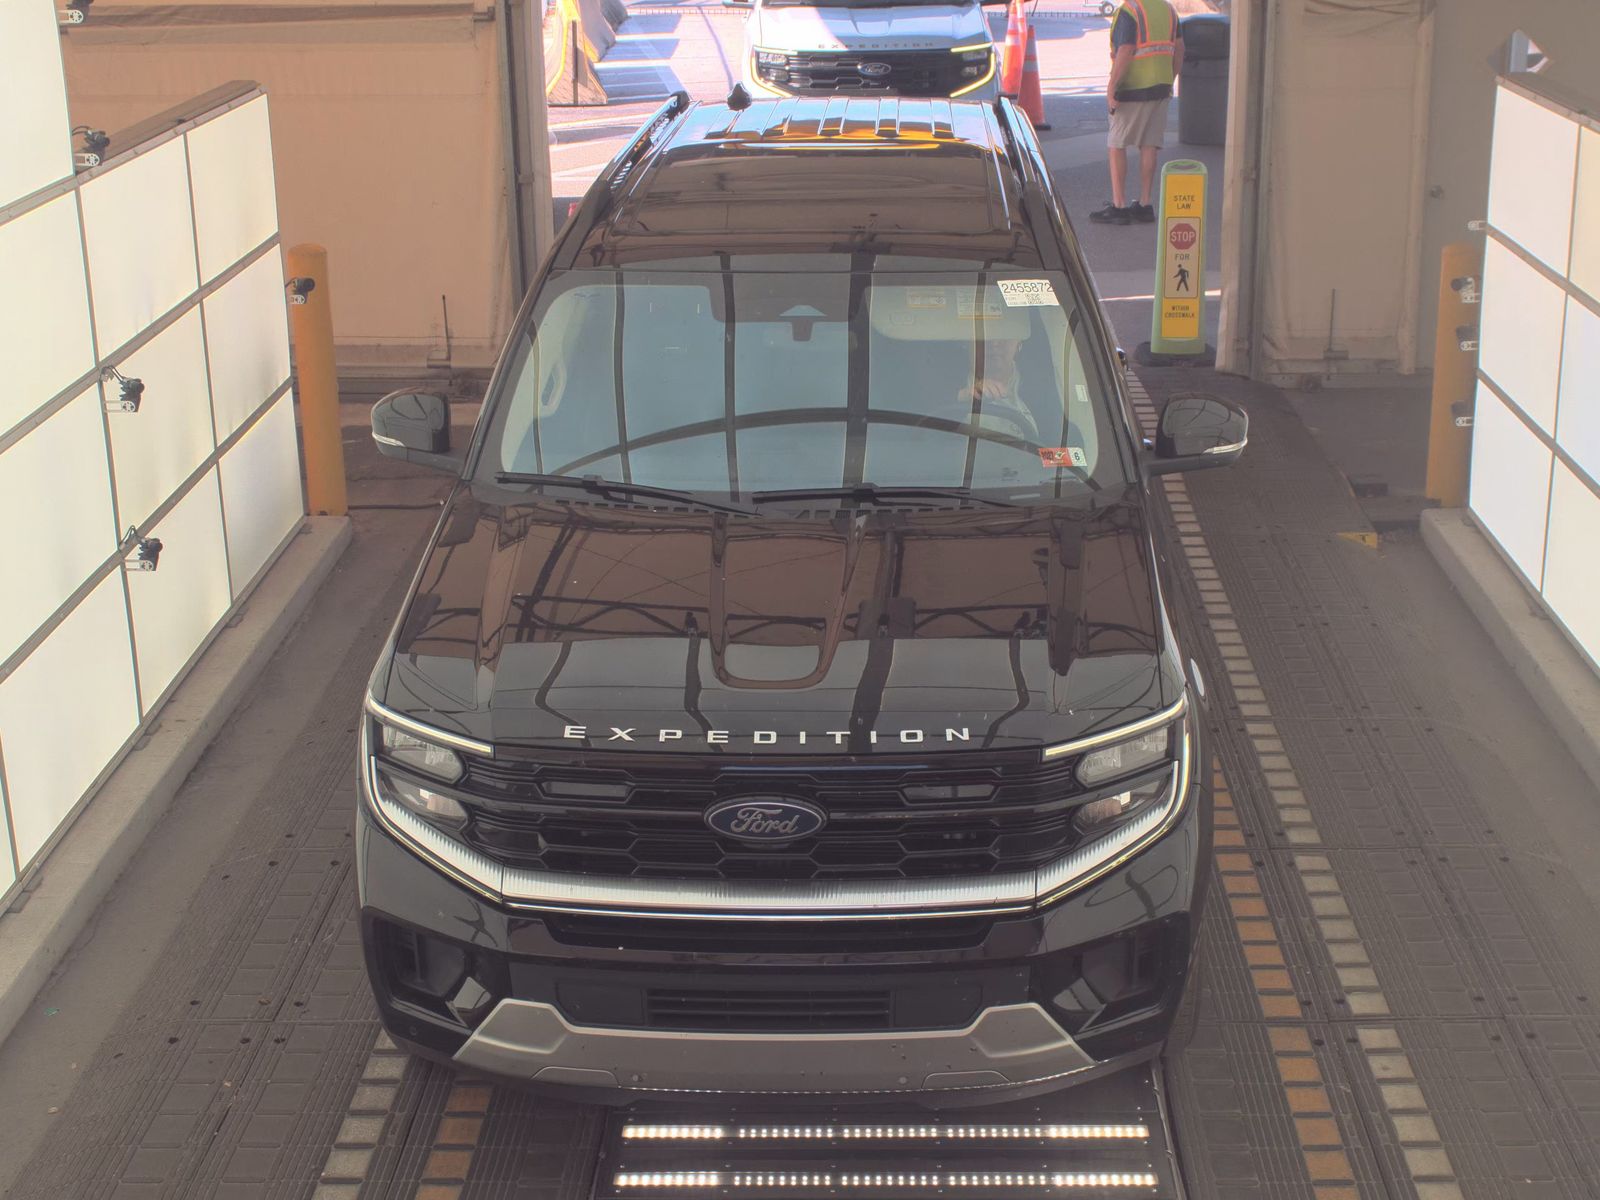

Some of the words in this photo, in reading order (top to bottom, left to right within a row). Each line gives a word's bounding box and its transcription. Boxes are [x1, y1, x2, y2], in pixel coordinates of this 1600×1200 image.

[1171, 231, 1195, 242] STOP
[1001, 282, 1053, 293] 2455872
[563, 725, 970, 744] EXPEDITION
[730, 807, 799, 834] Ford
